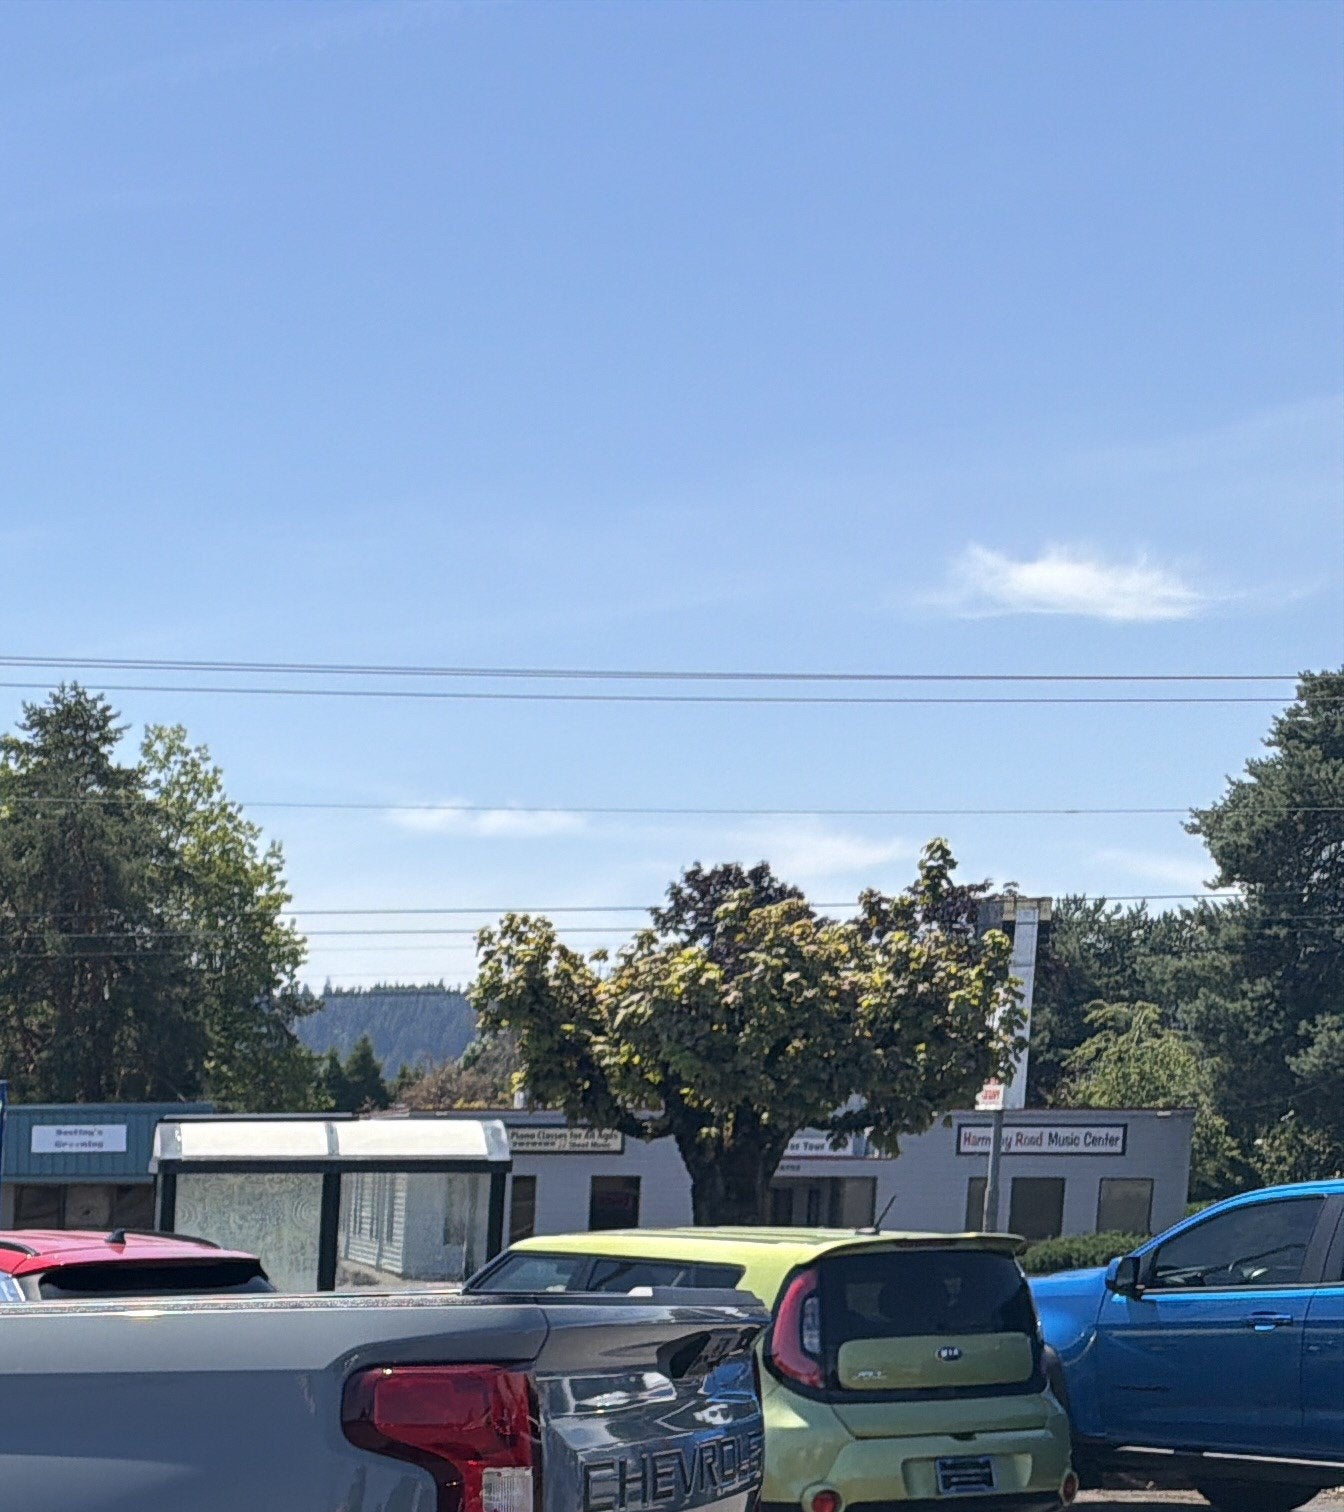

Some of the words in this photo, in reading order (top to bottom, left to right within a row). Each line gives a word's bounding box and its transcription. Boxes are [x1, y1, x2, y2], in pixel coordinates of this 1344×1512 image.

[511, 1130, 536, 1140] Piano
[537, 1130, 568, 1140] Classes
[569, 1130, 582, 1140] for
[1015, 1131, 1045, 1148] Road
[1047, 1131, 1080, 1148] Music
[1083, 1130, 1121, 1148] Center
